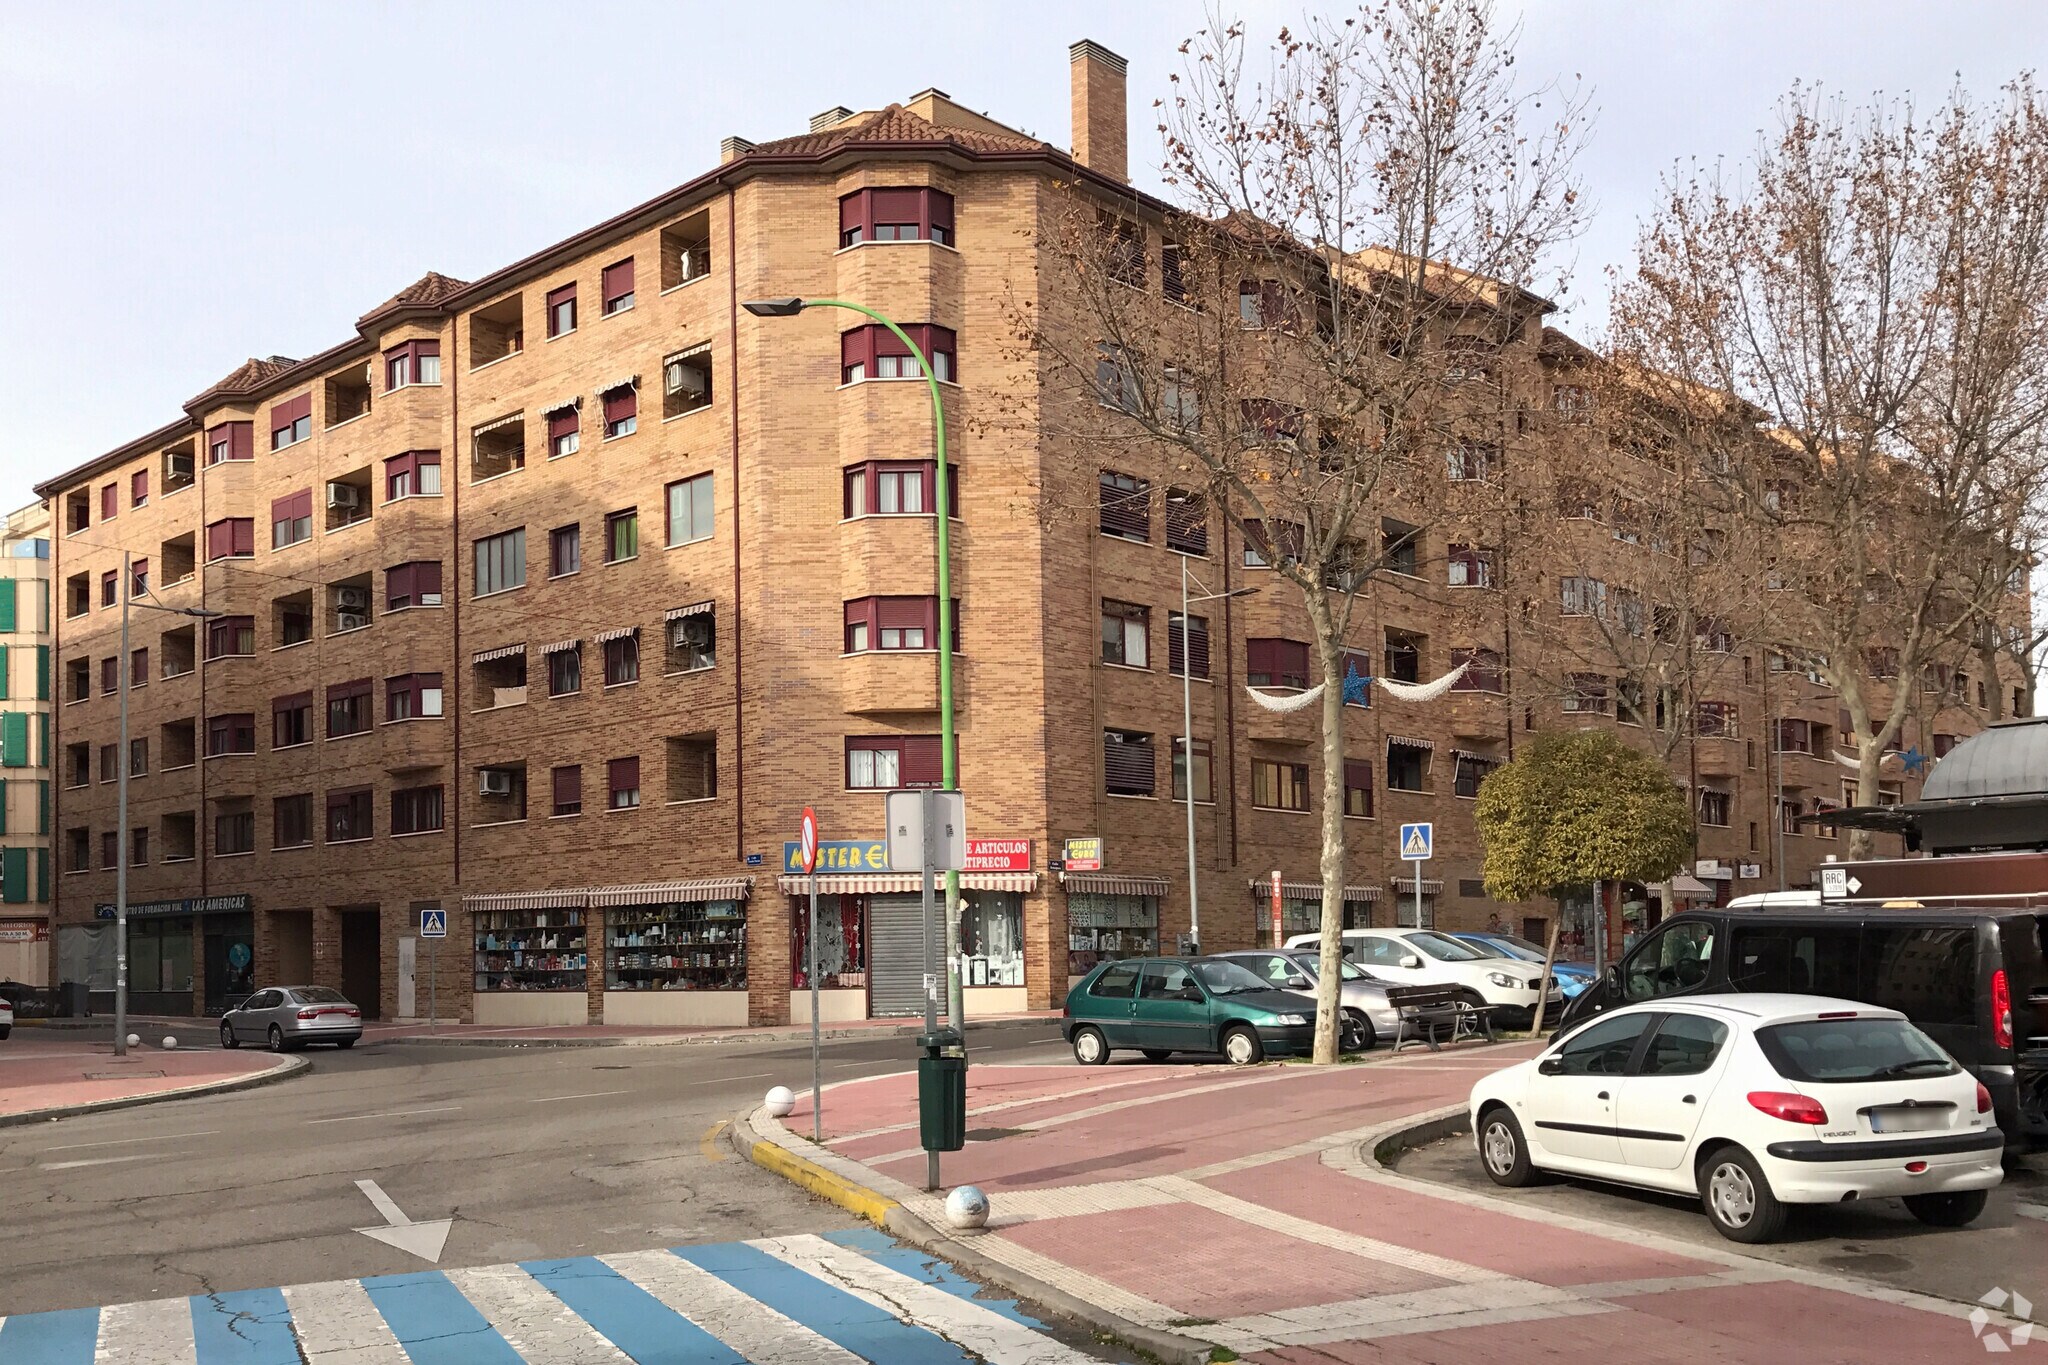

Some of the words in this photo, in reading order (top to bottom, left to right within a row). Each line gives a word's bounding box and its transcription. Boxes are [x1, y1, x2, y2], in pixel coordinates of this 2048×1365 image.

[974, 842, 1027, 854] ARTICULOS
[1069, 840, 1097, 849] MISTER
[790, 847, 862, 868] MSTER
[965, 856, 1010, 868] TIPRECIO
[145, 902, 171, 914] FORMACION
[192, 899, 205, 911] LAS
[206, 896, 245, 910] AMERICAS
[1823, 1130, 1857, 1138] PEUGEOT
